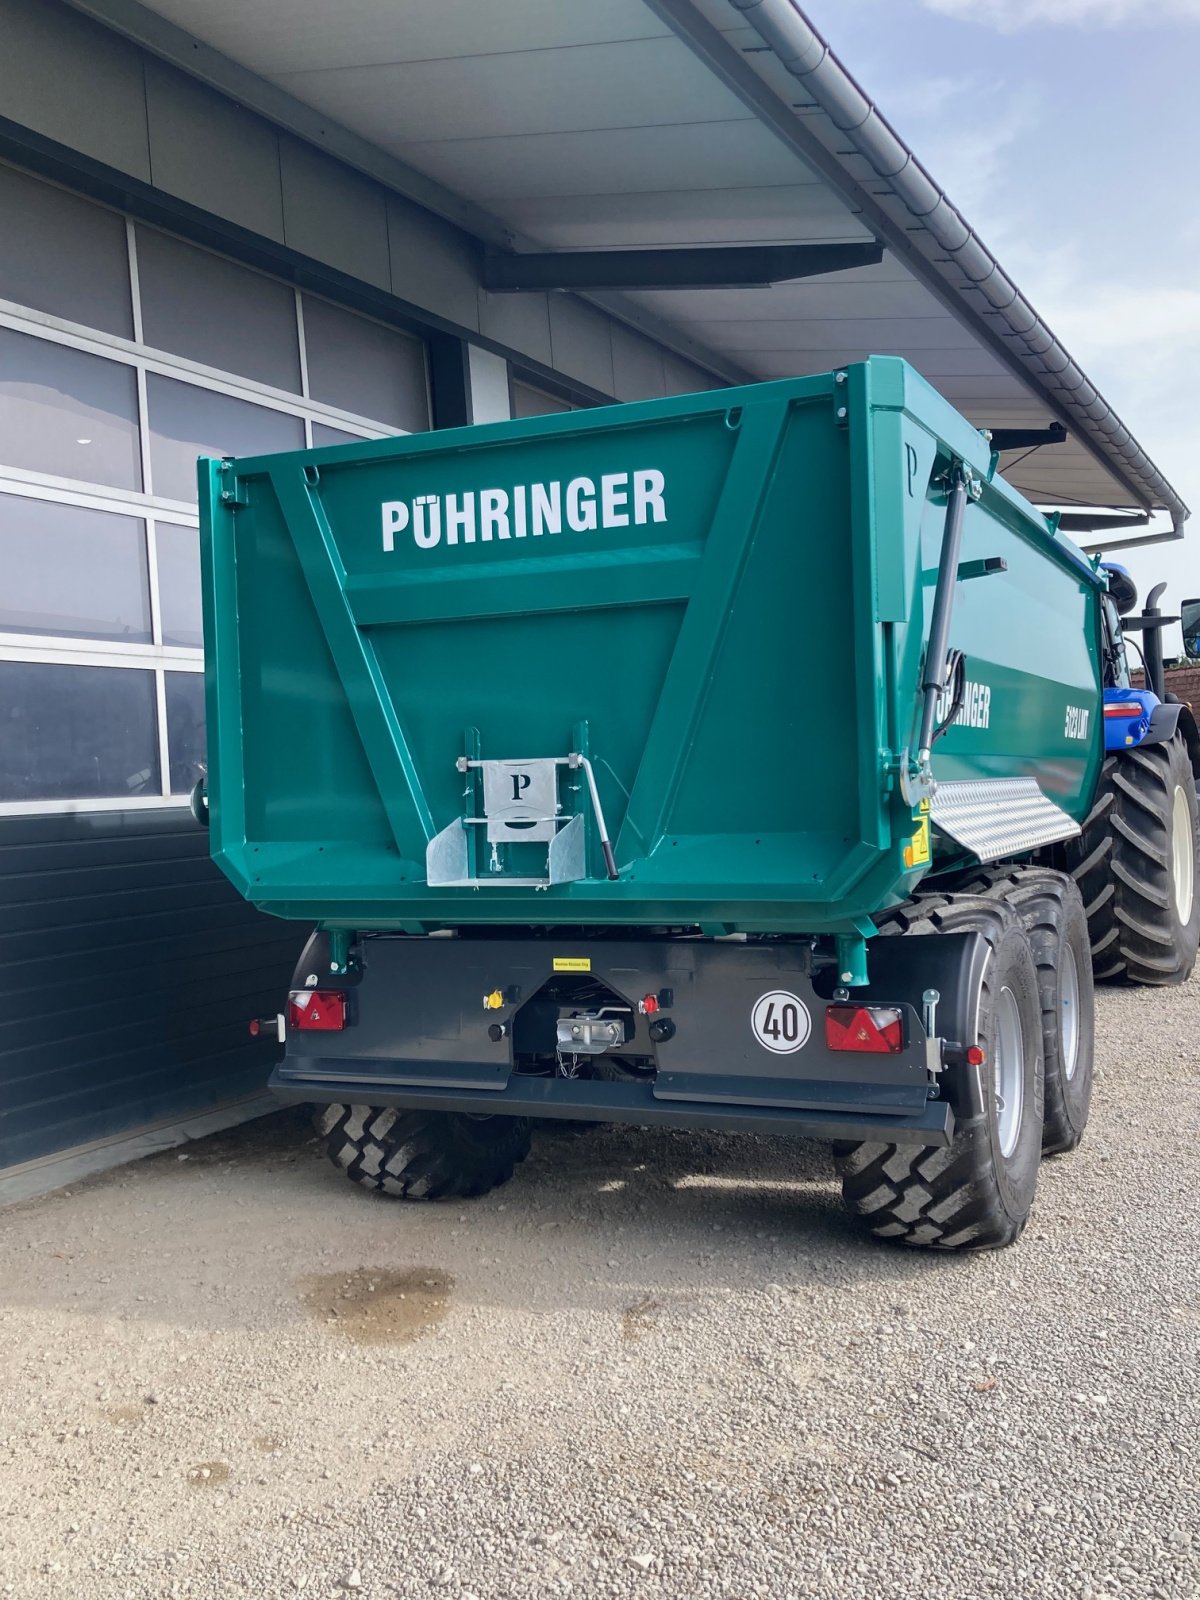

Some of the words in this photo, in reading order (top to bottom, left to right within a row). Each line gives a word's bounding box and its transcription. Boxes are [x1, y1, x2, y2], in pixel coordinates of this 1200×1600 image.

[381, 469, 668, 552] PÜHRINGER
[510, 774, 531, 801] P
[763, 1002, 798, 1041] 40
